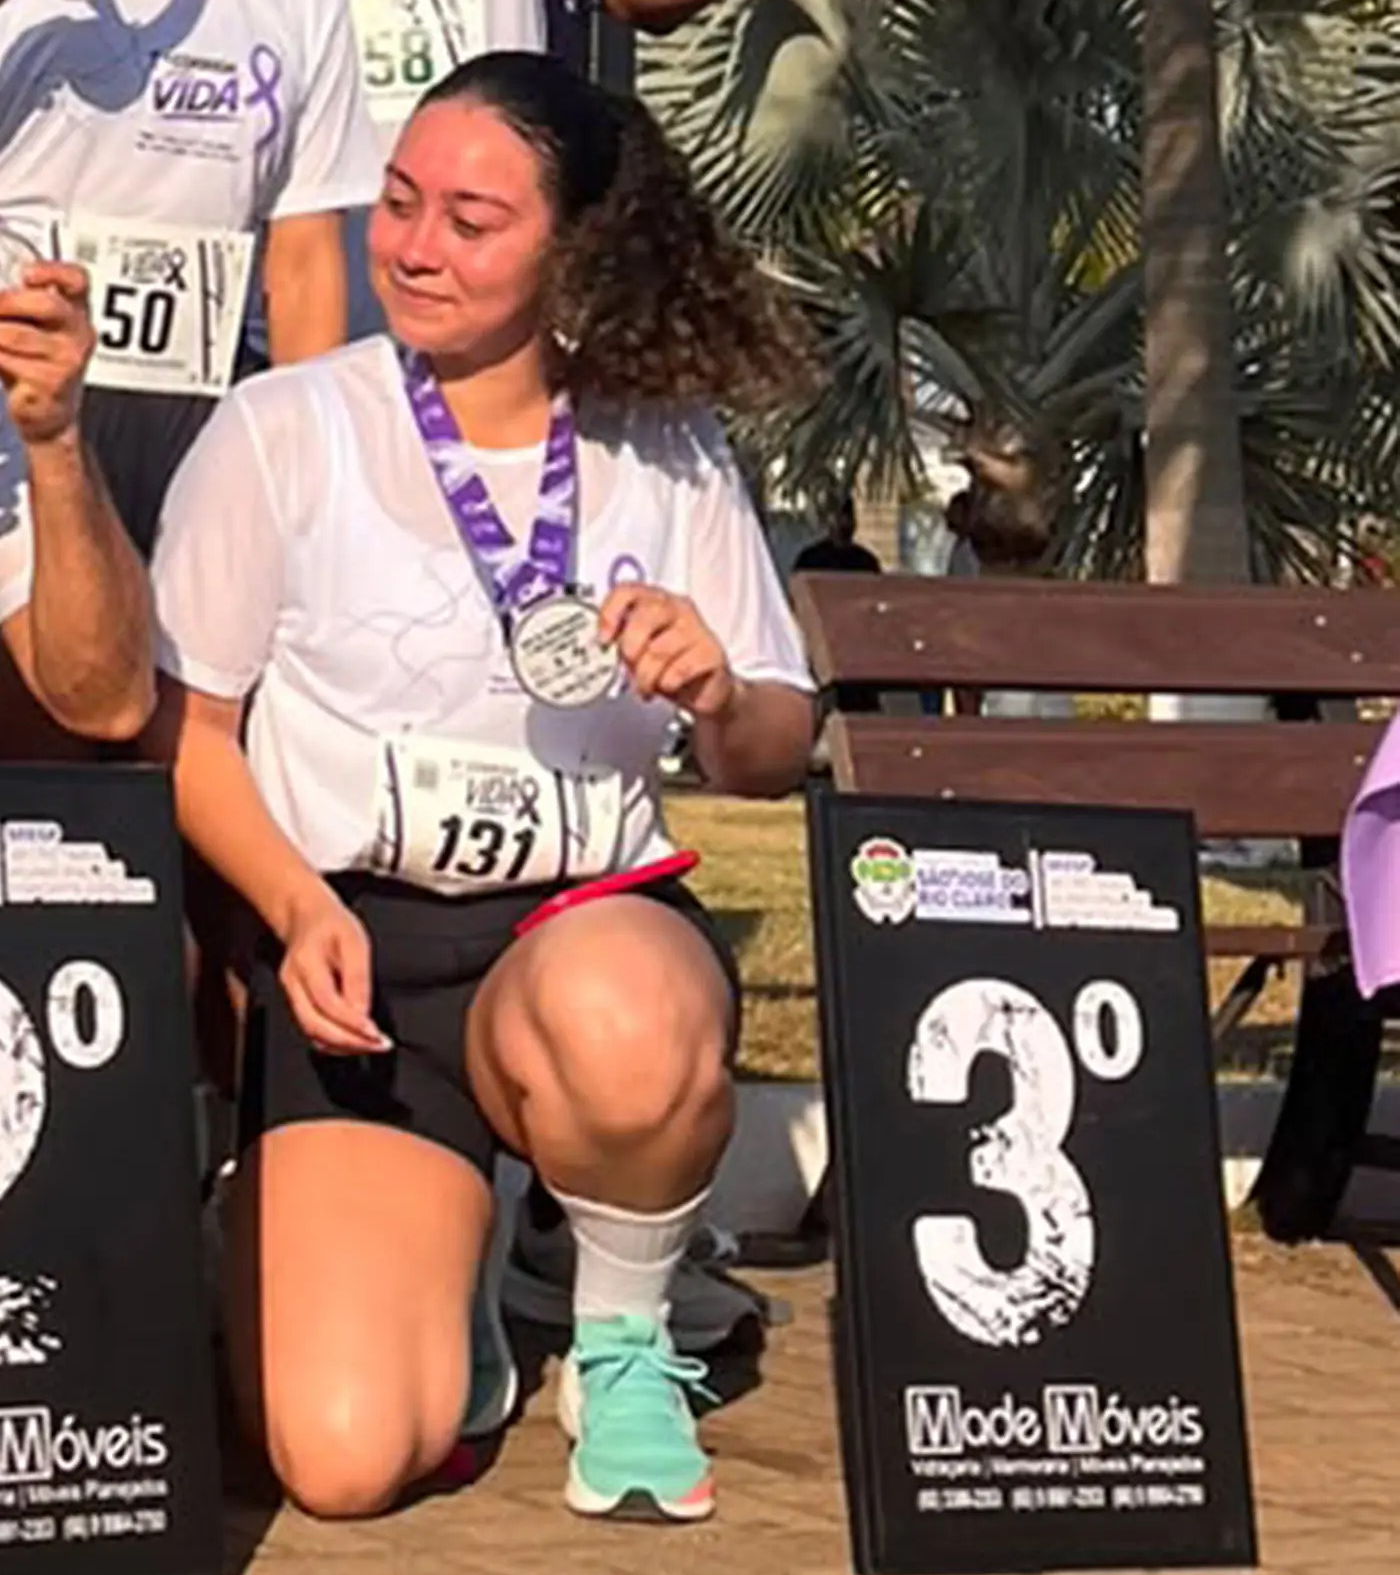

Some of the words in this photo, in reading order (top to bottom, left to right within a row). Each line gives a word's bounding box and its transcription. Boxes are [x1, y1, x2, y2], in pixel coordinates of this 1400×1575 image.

[154, 78, 238, 112] VIDA
[100, 284, 176, 354] 50
[433, 813, 536, 881] 131
[905, 1385, 1042, 1455] Made
[1044, 1385, 1203, 1455] Móveis
